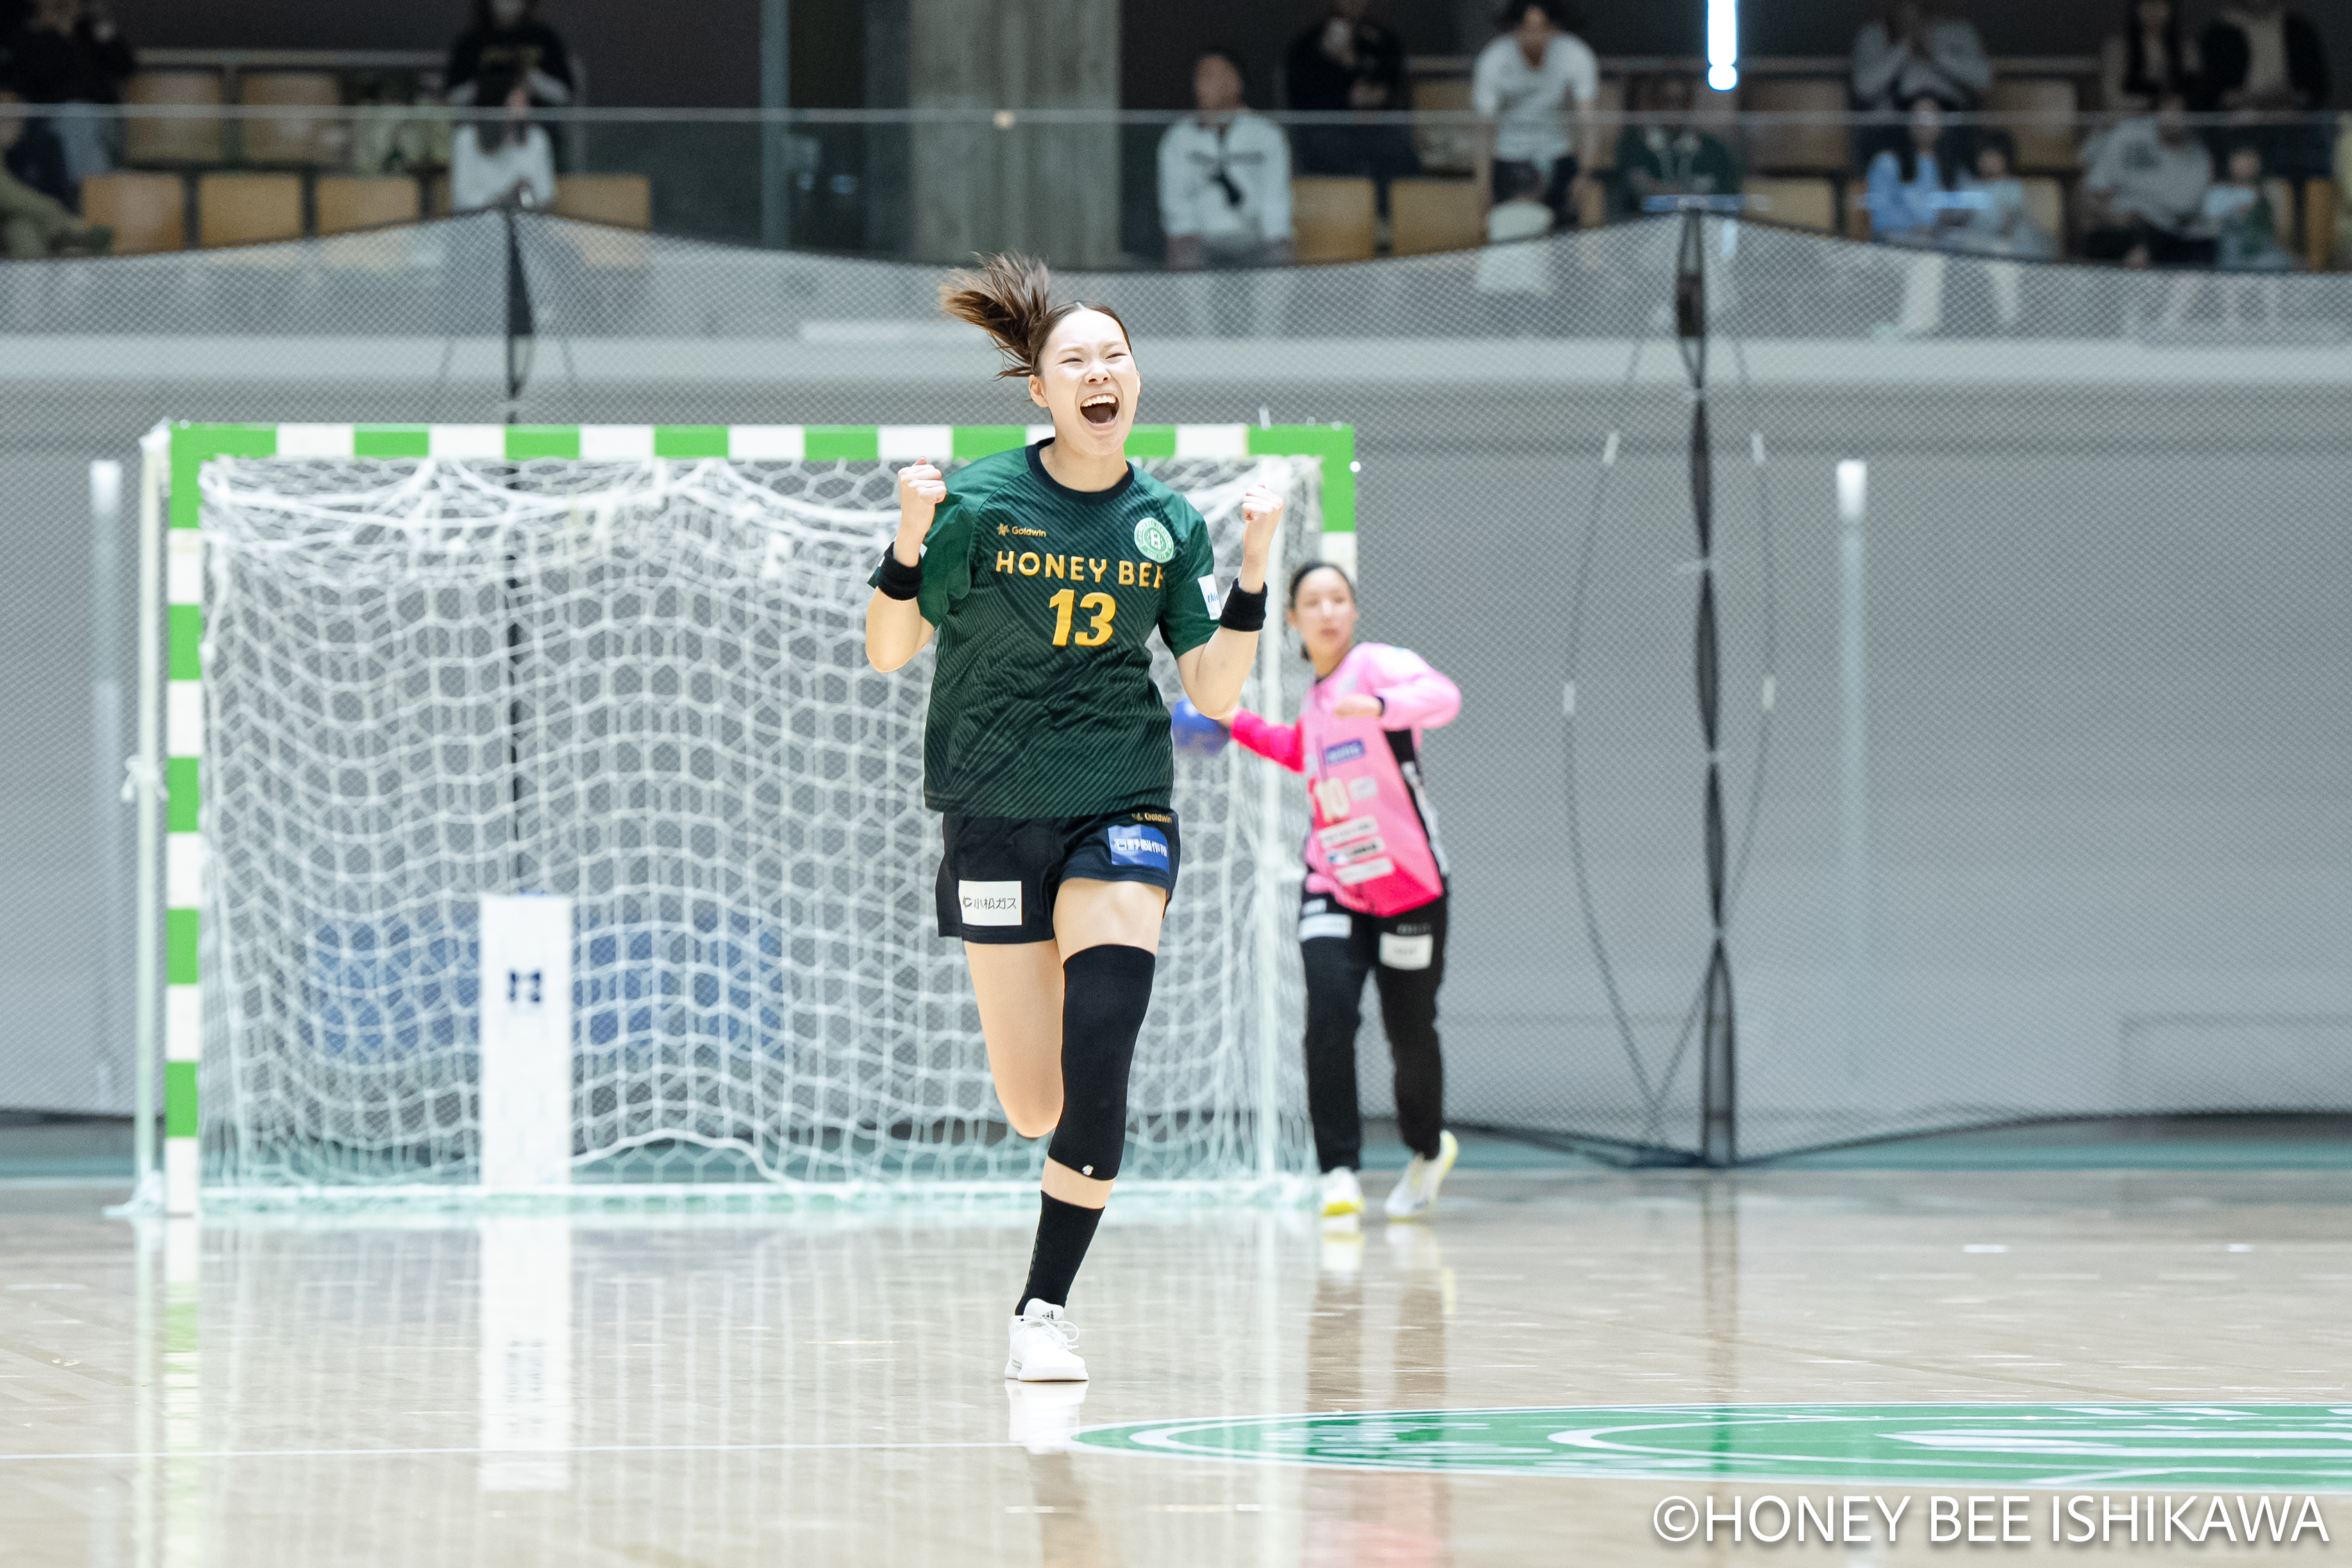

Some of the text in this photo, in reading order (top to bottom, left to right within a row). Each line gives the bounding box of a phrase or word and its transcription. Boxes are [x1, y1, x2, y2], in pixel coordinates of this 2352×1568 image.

[1011, 526, 1047, 537] Goldwin
[996, 550, 1108, 583] HONEY
[1049, 588, 1117, 647] 13
[1144, 812, 1173, 824] Goldwin
[973, 897, 1017, 910] 小松ガス
